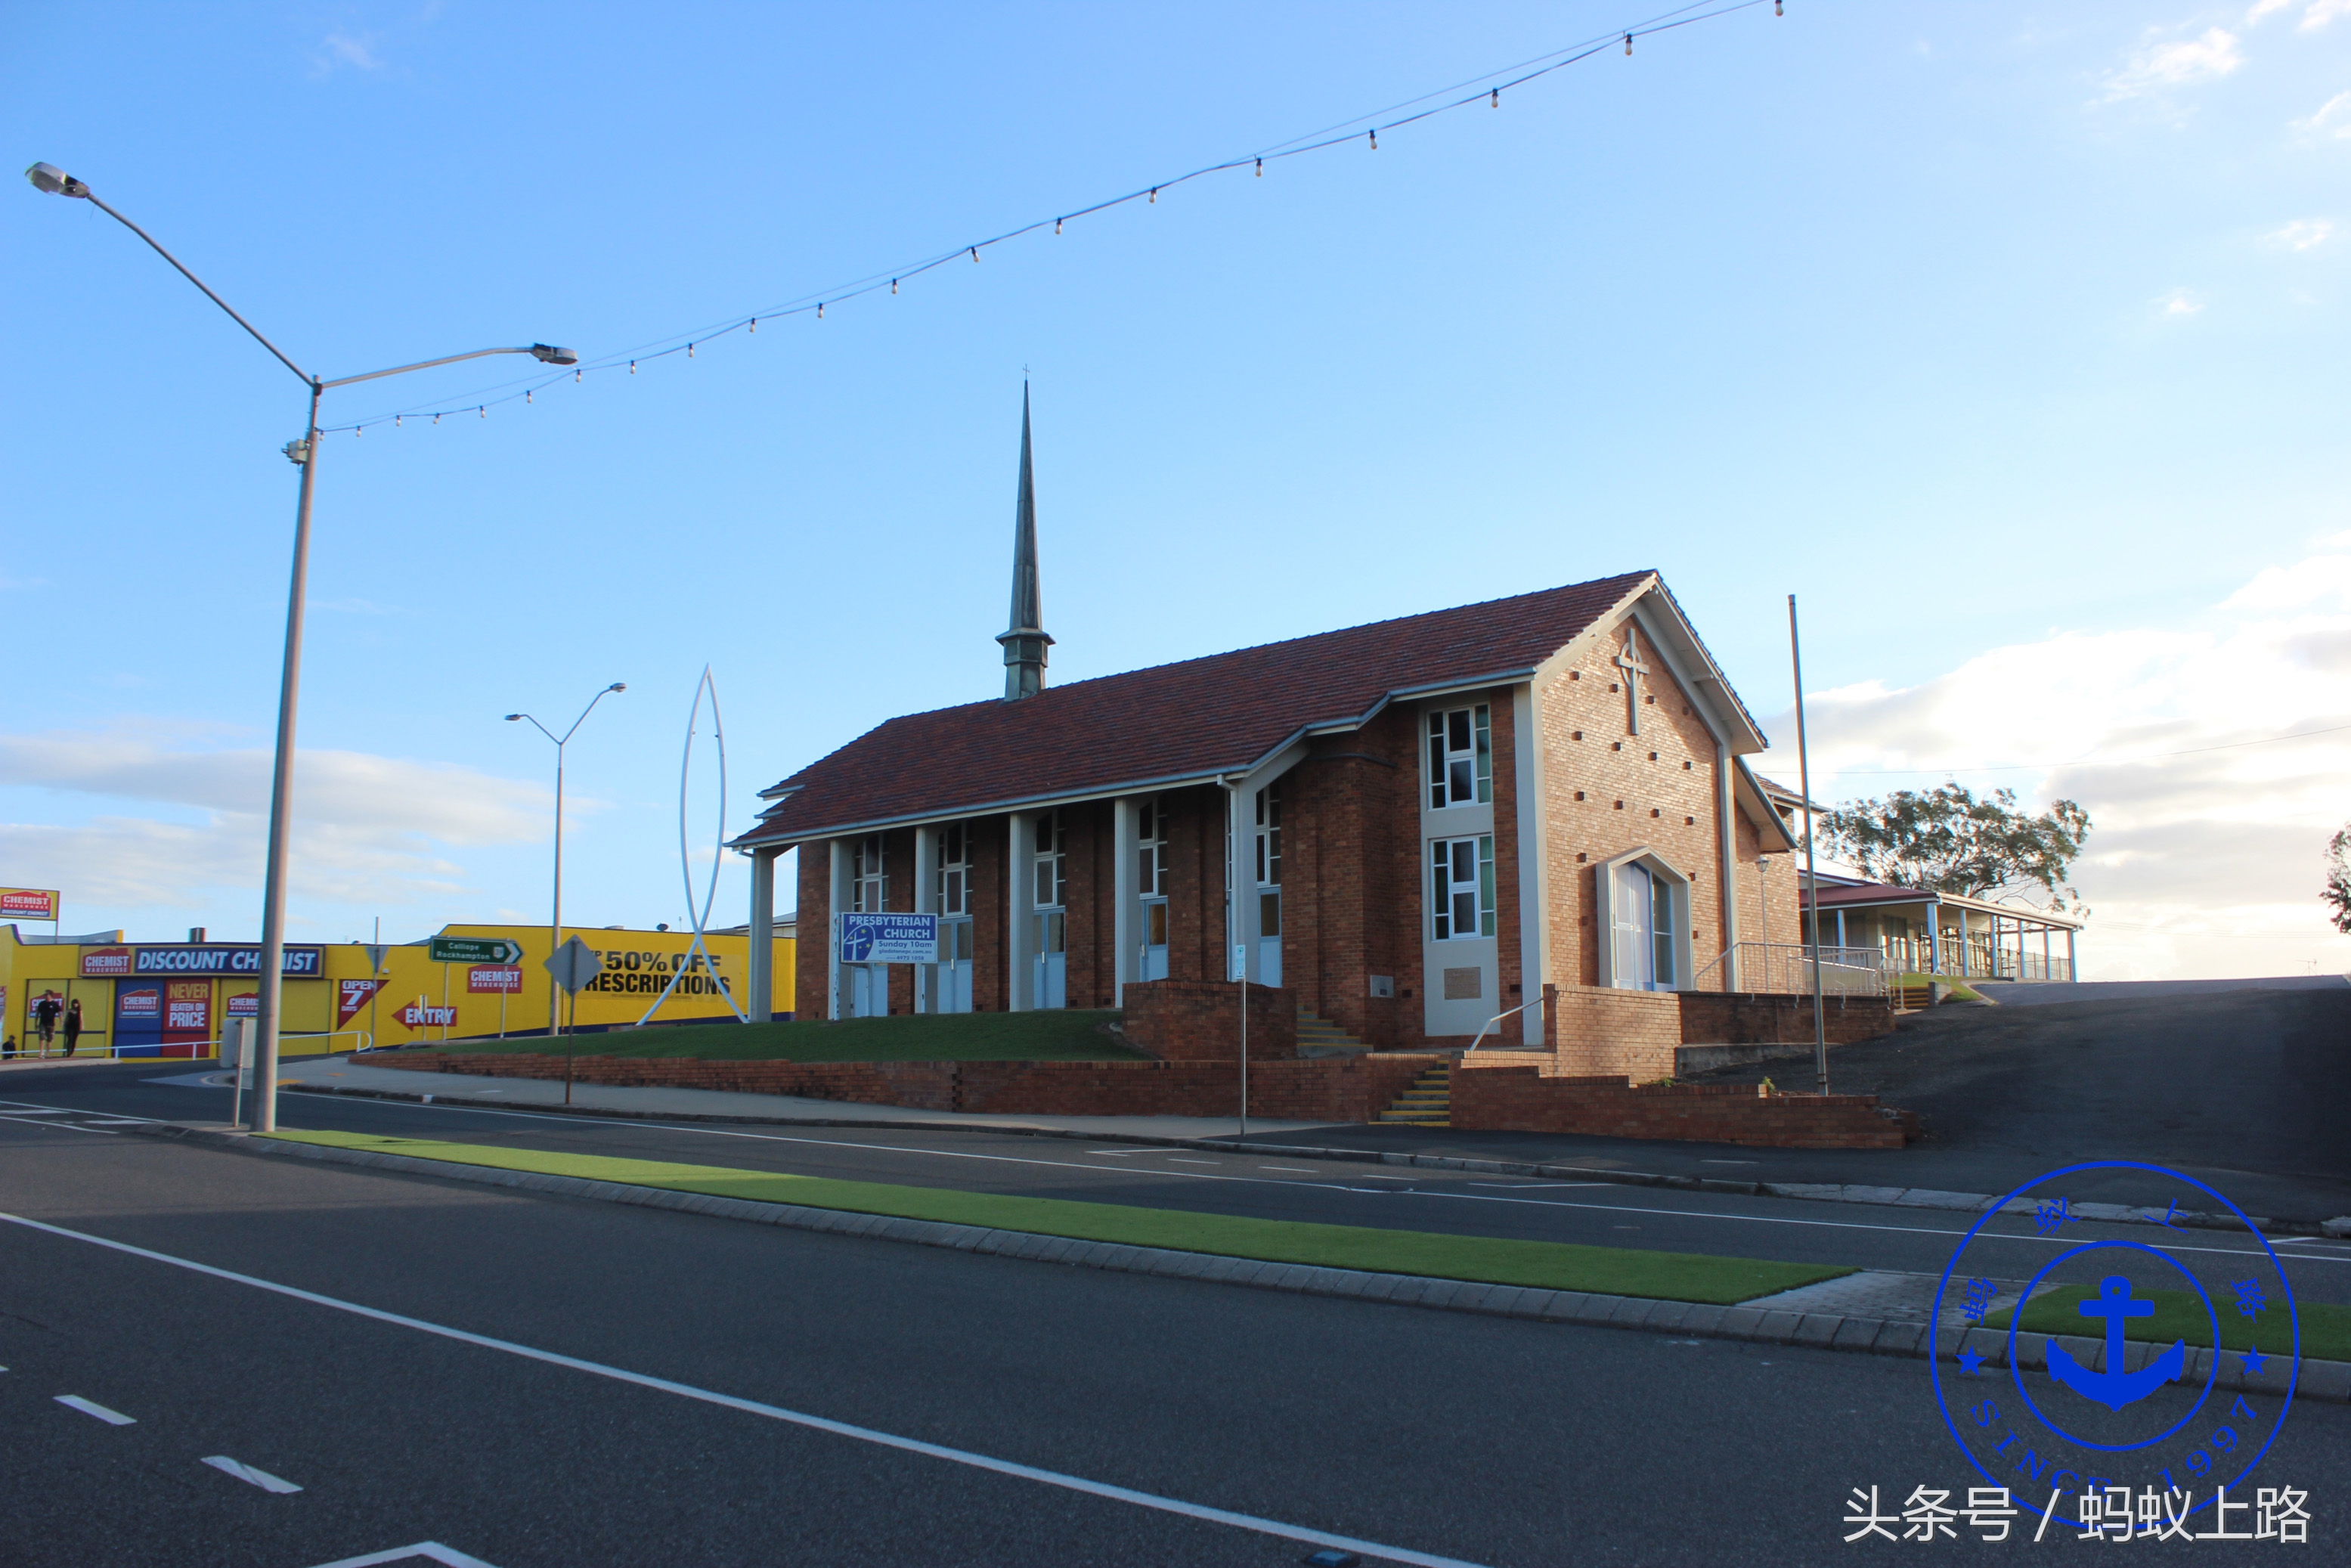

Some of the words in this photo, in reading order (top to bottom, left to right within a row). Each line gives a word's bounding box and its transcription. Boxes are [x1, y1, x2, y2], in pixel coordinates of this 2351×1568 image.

[3, 895, 49, 906] CHEMIST
[849, 916, 931, 926] PRESBYTERIAN
[884, 928, 931, 938] CHURCH
[448, 942, 480, 950] Calliope
[878, 940, 907, 949] Sunday
[137, 950, 228, 970] DISCOUNT
[436, 951, 491, 959] Rockhampton
[85, 956, 129, 967] CHEMIST
[606, 950, 668, 971] 50%
[671, 953, 721, 973] OFF
[470, 971, 520, 982] CHEMIST
[169, 984, 209, 999] NEVER
[123, 996, 157, 1006] CHEMIST
[342, 990, 364, 1006] 7
[169, 1003, 194, 1012] BEATEN
[195, 1003, 206, 1012] ON
[169, 1012, 206, 1027] PRICE
[405, 1008, 454, 1024] ENTRY
